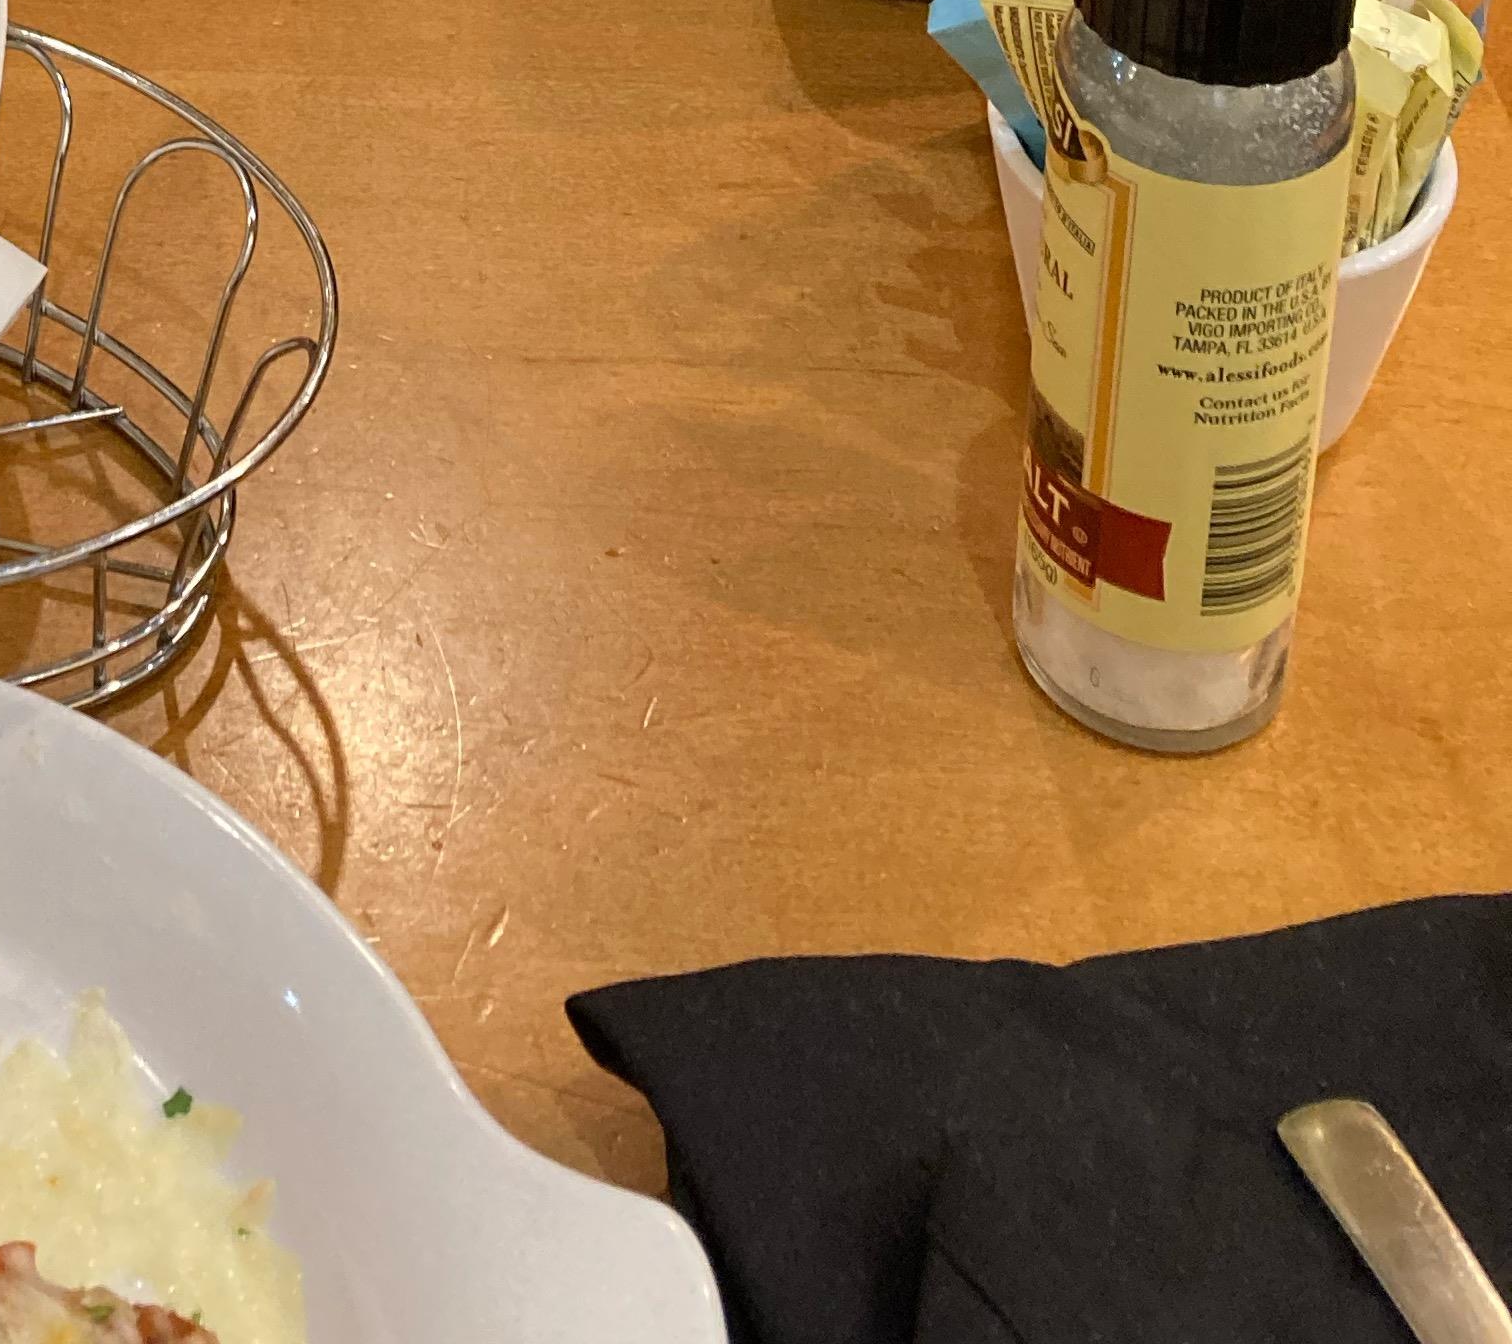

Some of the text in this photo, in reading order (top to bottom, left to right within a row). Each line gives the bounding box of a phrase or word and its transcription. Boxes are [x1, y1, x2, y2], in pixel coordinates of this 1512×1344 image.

[1200, 285, 1273, 305] PRODUCT
[1276, 279, 1294, 299] OF
[1175, 301, 1238, 322] PACKED
[1241, 305, 1257, 321] IN
[1261, 298, 1287, 318] THE
[1187, 320, 1225, 338] VIGO
[1229, 308, 1303, 338] IMPORTING
[1172, 335, 1231, 357] TAMPA,
[1236, 339, 1253, 355] FL
[1199, 373, 1312, 411] Contact us for
[1193, 405, 1277, 426] Nutrition
